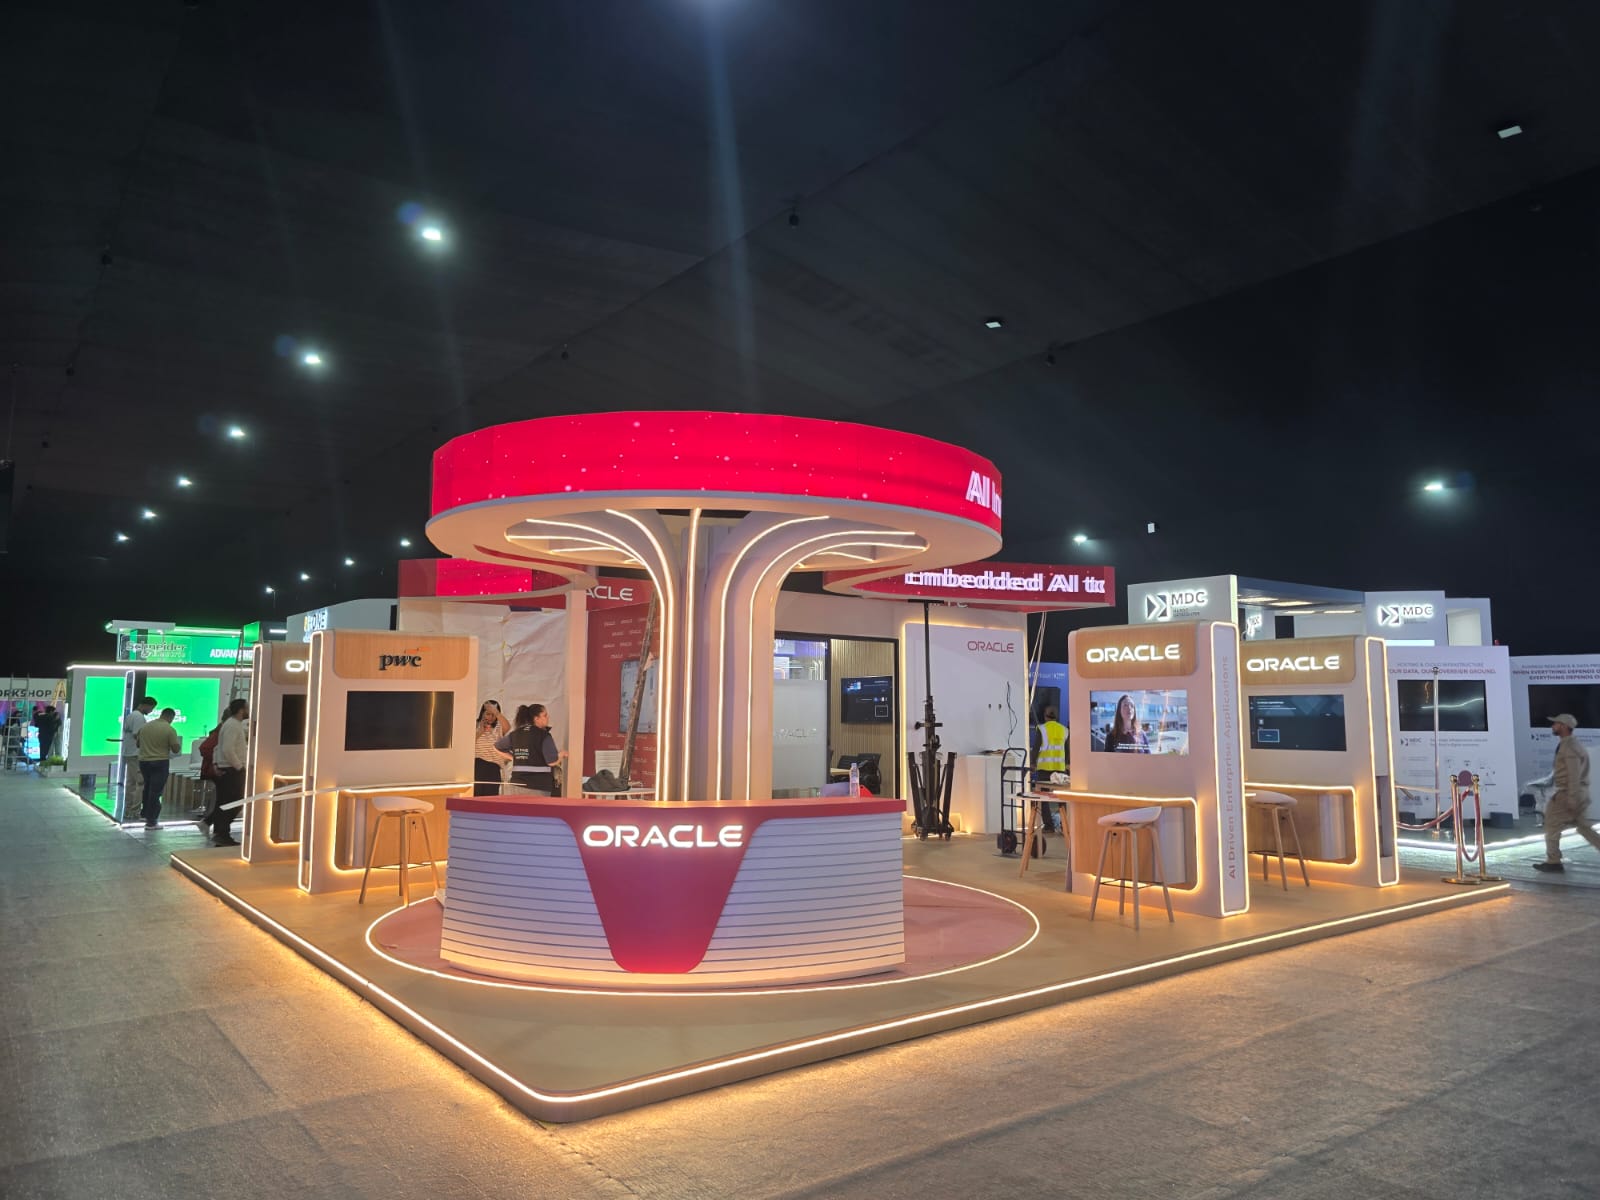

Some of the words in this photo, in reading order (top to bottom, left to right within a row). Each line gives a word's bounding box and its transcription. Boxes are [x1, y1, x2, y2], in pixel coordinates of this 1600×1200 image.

[586, 585, 634, 602] ACLE
[1171, 591, 1206, 606] MDC
[1402, 605, 1434, 616] MDC
[967, 640, 1016, 654] ORACLE
[1086, 644, 1181, 663] ORACLE
[379, 655, 423, 671] pwc
[1246, 655, 1341, 672] ORACLE
[0, 689, 52, 698] RKSHOP
[1221, 655, 1232, 739] Applications
[1224, 743, 1235, 813] Enterprise
[583, 824, 744, 849] ORACLE
[1226, 816, 1236, 862] Driven
